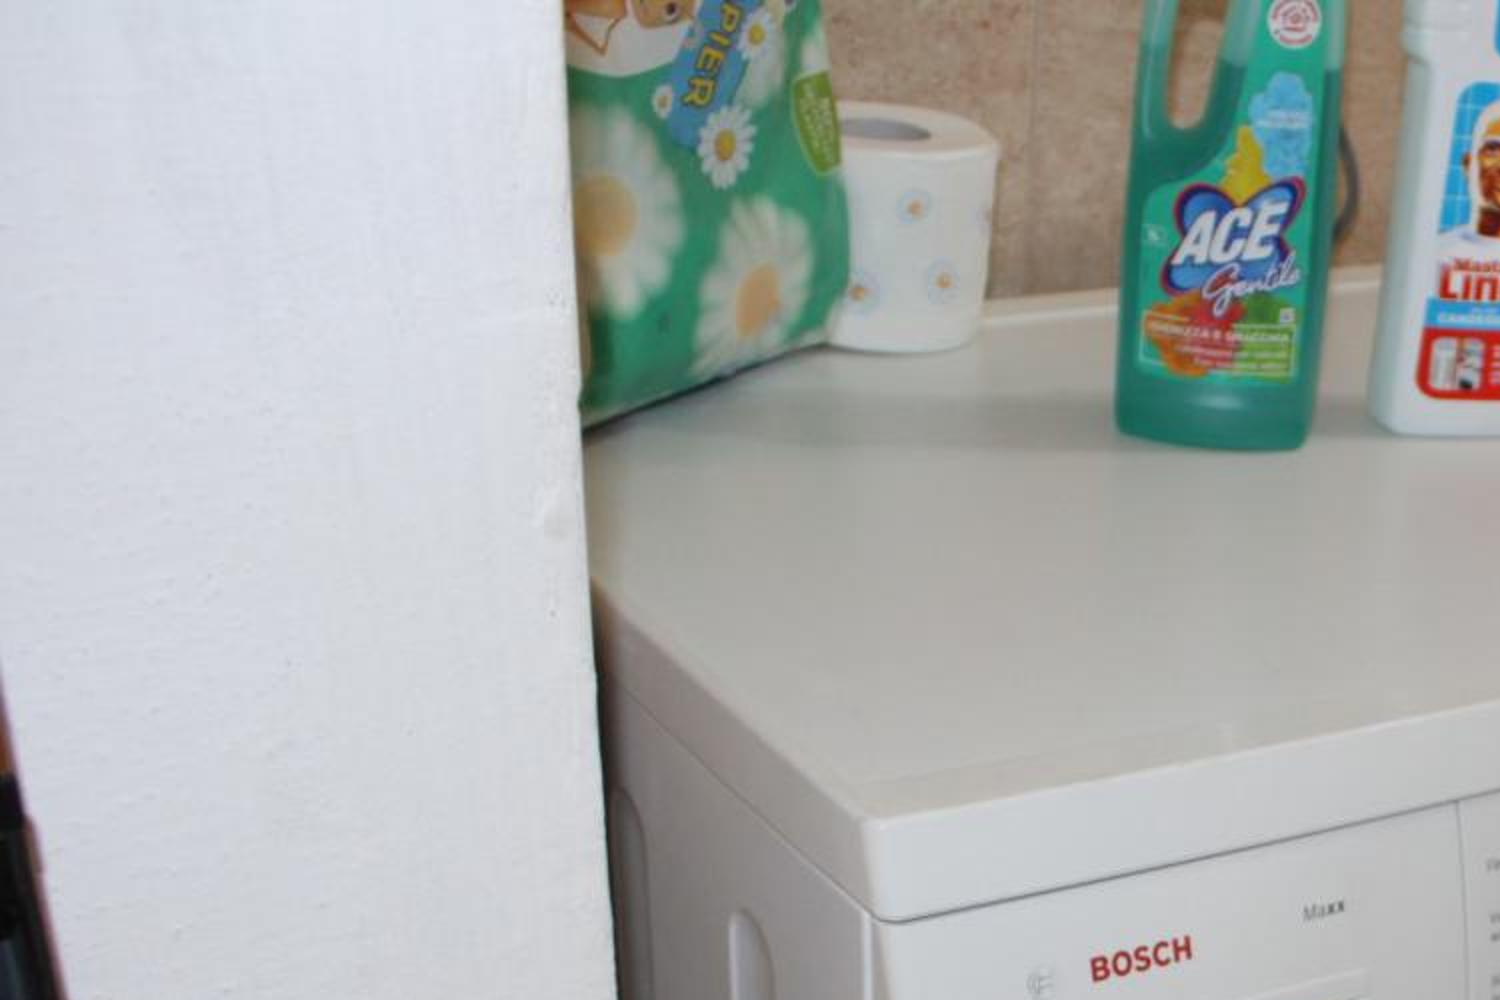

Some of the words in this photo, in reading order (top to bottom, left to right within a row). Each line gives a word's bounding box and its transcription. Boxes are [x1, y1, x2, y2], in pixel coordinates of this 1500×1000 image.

[1170, 199, 1291, 267] ACE
[1202, 250, 1301, 318] Gentile
[1089, 935, 1194, 983] BOSCH
